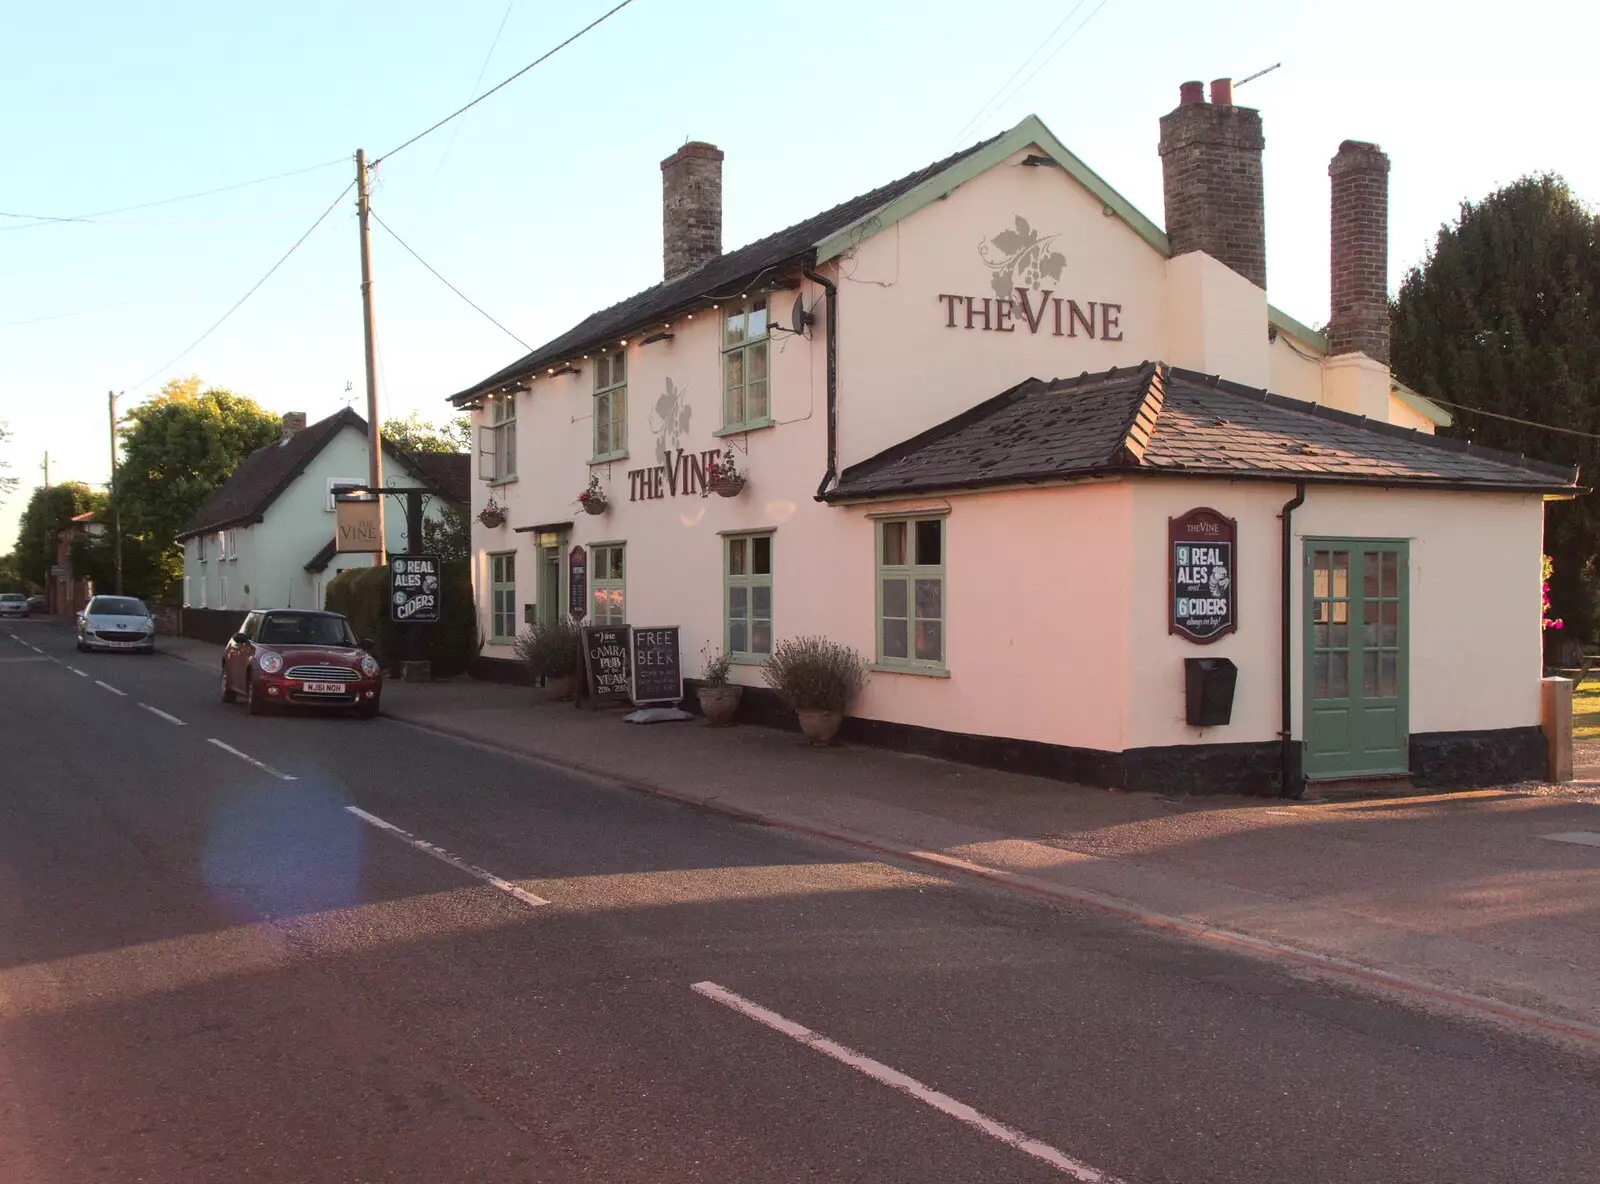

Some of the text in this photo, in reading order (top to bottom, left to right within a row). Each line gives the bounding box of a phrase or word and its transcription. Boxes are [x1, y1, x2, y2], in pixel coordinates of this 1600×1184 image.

[938, 287, 1123, 341] THE VINE
[628, 466, 664, 502] THE
[340, 525, 377, 540] VINE
[1178, 548, 1223, 565] 9 REAL
[395, 560, 434, 573] 9 REAL
[395, 574, 421, 587] ALES
[1177, 567, 1208, 584] ALES
[396, 591, 403, 604] 6
[397, 595, 435, 619] CIDERS
[1179, 598, 1227, 616] 6 CIDERS
[637, 631, 672, 646] FREE
[591, 645, 626, 659] CAMRA
[637, 649, 674, 665] BEER
[600, 657, 621, 669] PUB
[596, 673, 628, 686] YEAR
